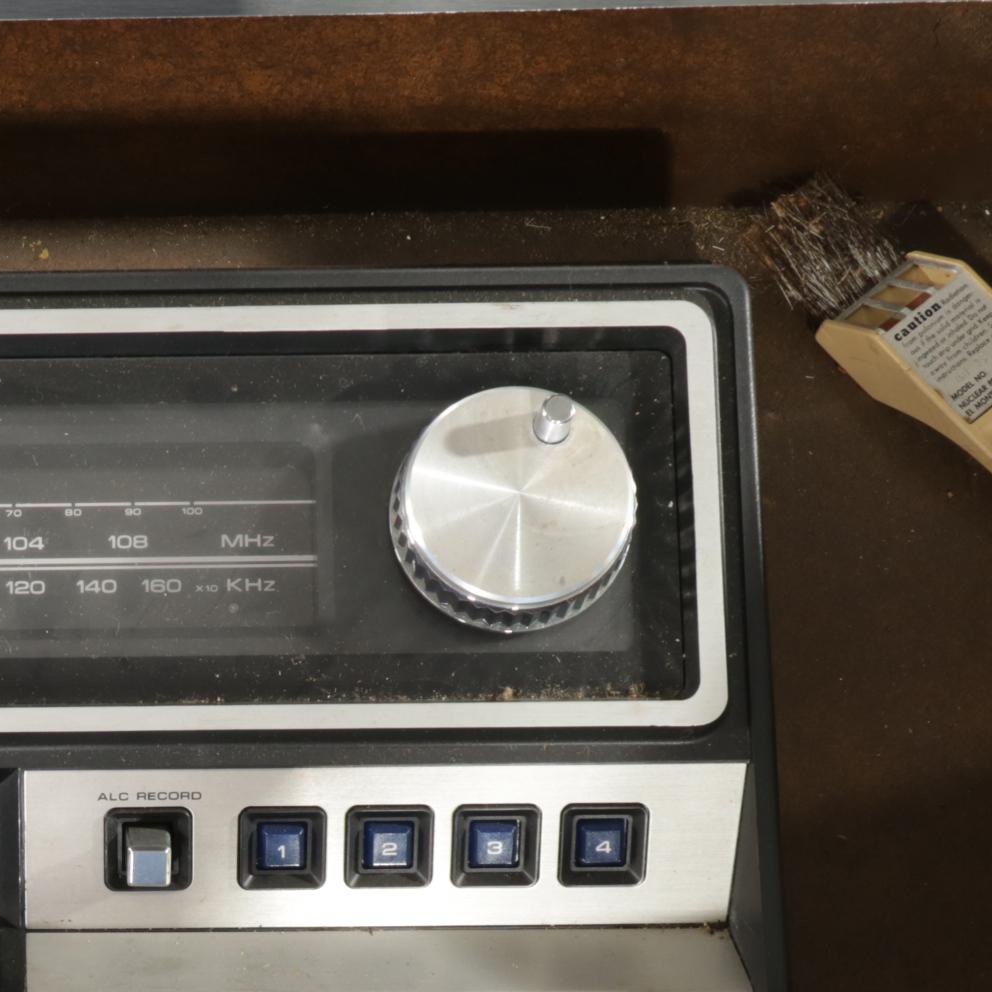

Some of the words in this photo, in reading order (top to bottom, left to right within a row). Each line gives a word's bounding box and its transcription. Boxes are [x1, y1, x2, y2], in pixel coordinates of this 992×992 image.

[894, 303, 941, 341] caution
[950, 382, 975, 400] MODEL
[958, 384, 988, 409] NUCLEAR
[5, 509, 22, 518] 70
[64, 508, 82, 517] 80
[124, 507, 142, 516] 90
[181, 507, 203, 516] 100
[3, 536, 45, 551] 104
[108, 534, 148, 550] 108
[220, 533, 274, 548] MHz
[5, 580, 46, 595] 120
[76, 578, 117, 594] 140
[141, 578, 182, 593] 160
[226, 577, 275, 592] KHz
[97, 791, 129, 802] ALC
[136, 791, 202, 801] RECORD
[276, 844, 285, 858] 1
[381, 842, 398, 856] 2
[486, 840, 503, 855] 3
[594, 840, 612, 853] 4
